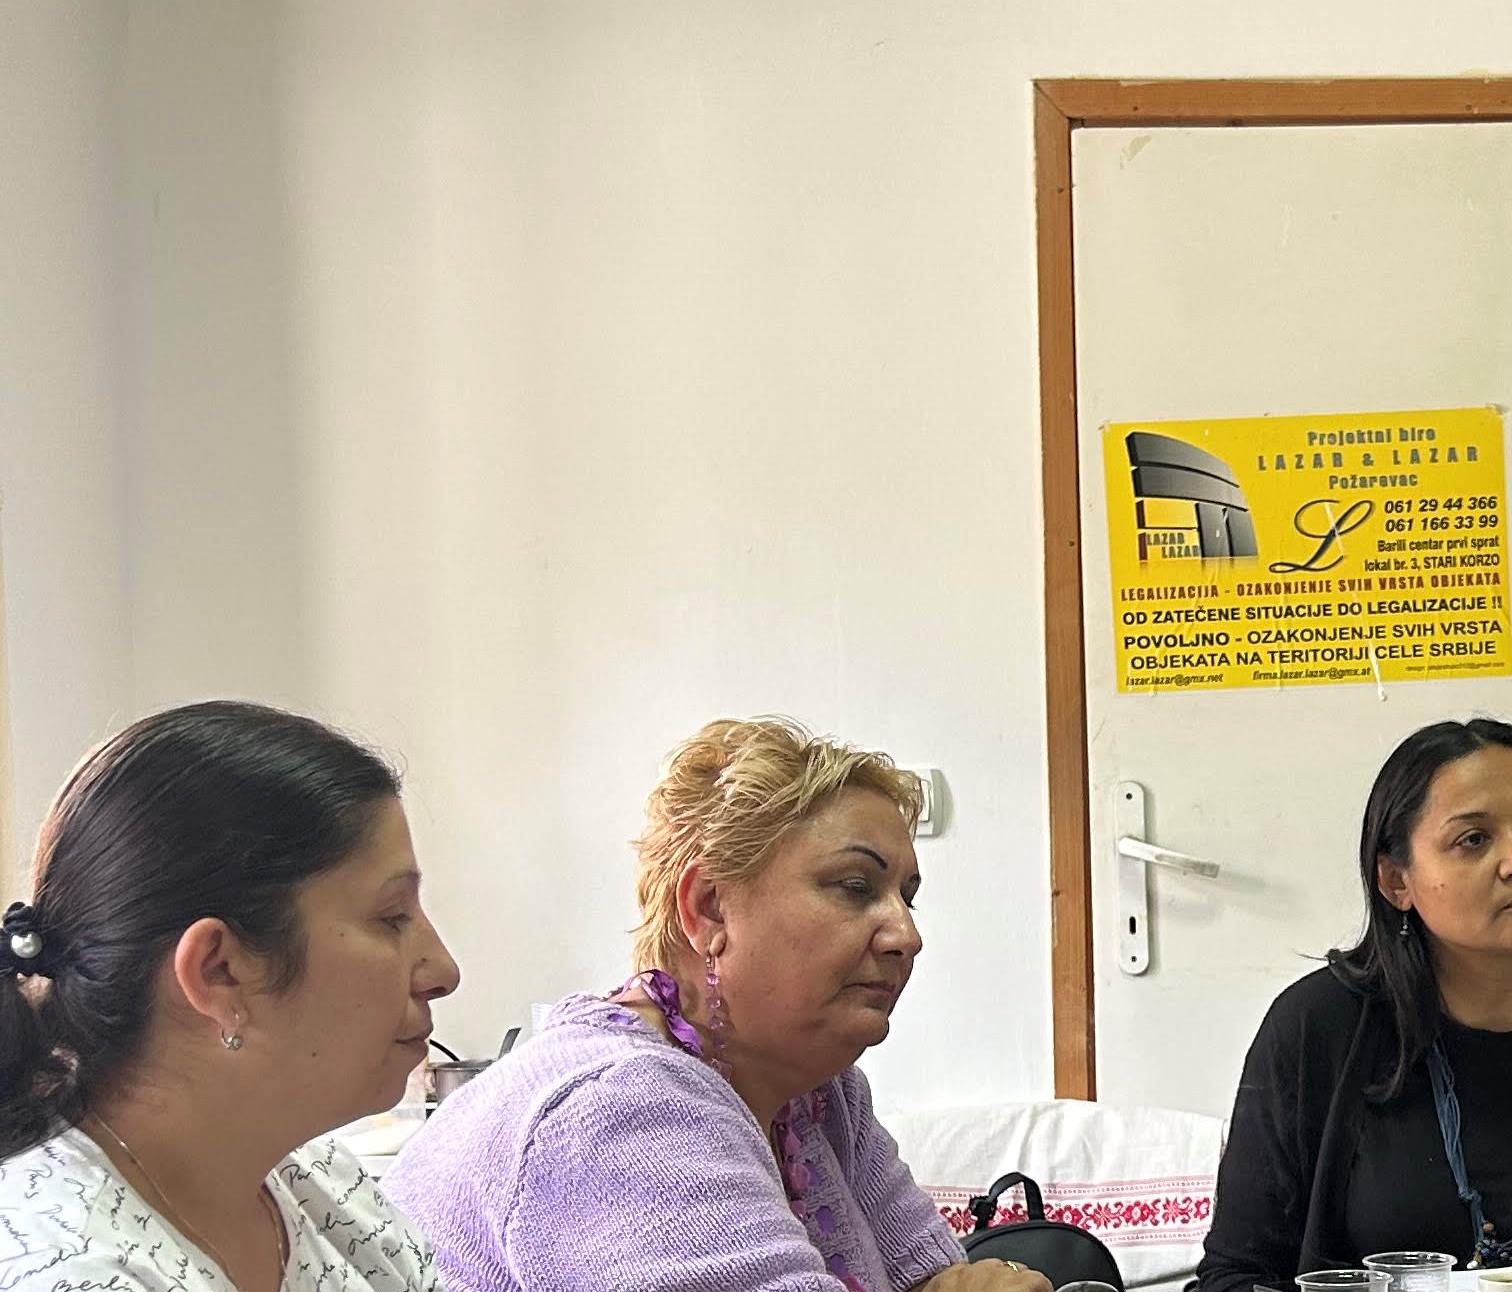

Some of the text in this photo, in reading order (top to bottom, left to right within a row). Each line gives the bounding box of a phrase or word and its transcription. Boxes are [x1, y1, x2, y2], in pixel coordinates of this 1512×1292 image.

[1308, 427, 1436, 446] Projektni biro
[1258, 446, 1478, 471] LAZAR & LAZAR
[1329, 474, 1418, 490] Požarevac
[1384, 496, 1498, 514] 061 29 44 366
[1385, 515, 1498, 533] 061 166 33 99
[1409, 538, 1444, 551] centar
[1471, 536, 1500, 551] sprat
[1364, 558, 1392, 572] lokal
[1423, 555, 1457, 570] STARI
[1460, 553, 1500, 568] KORZO
[1121, 584, 1219, 602] LEGALIZACIJA
[1237, 578, 1333, 597] OZAKONJENJE
[1338, 578, 1373, 593] SVIH
[1379, 576, 1425, 591] VRSTA
[1431, 573, 1501, 588] OBJEKATA
[1122, 611, 1148, 625] OD
[1152, 605, 1241, 624] ZATEČENE
[1245, 603, 1333, 620] SITUACIJE
[1337, 602, 1362, 616] DO
[1367, 597, 1487, 615] LEGALIZACIJE
[1124, 632, 1230, 650] POVOLJNO
[1247, 625, 1386, 645] OZAKONJENJE
[1392, 623, 1435, 638] SVIH
[1440, 620, 1503, 636] VRSTA
[1131, 640, 1497, 670] OBJEKATA NA TERITORIJI CELE SRBIJE
